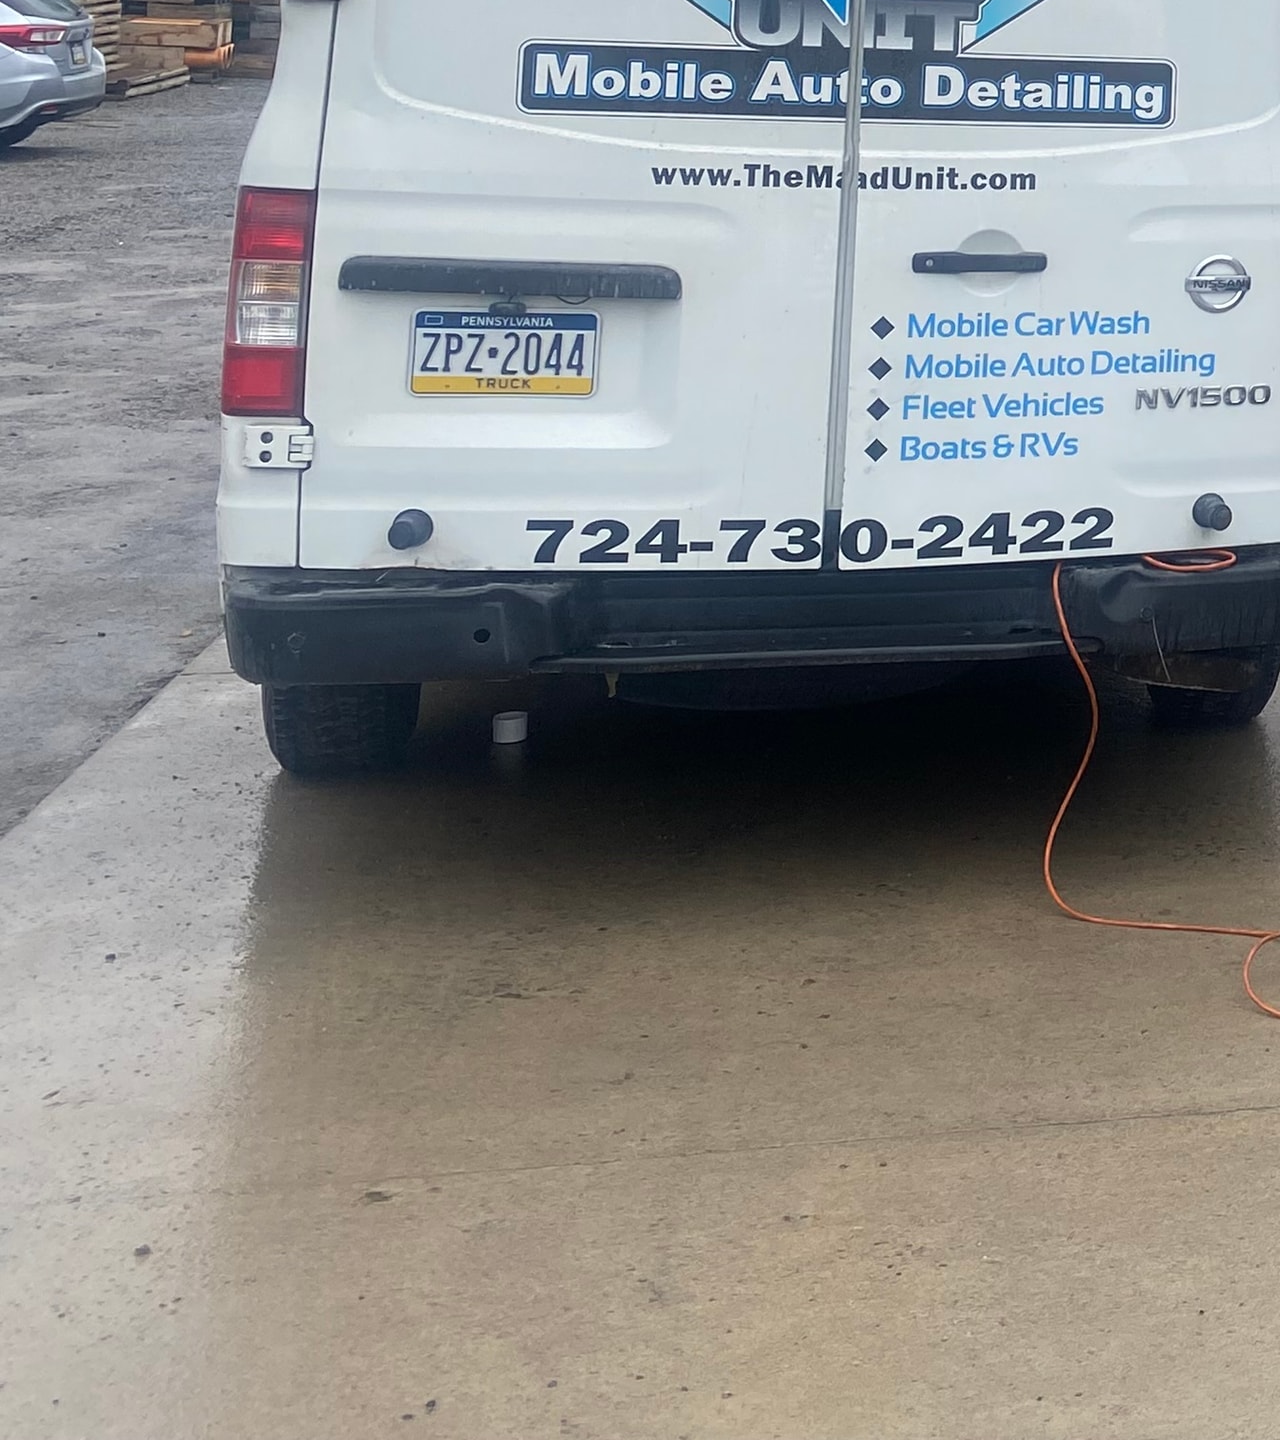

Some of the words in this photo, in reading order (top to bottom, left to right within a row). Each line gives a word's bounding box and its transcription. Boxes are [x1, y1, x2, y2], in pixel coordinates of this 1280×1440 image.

[533, 52, 733, 102] Mobile
[751, 60, 903, 107] Auto
[923, 65, 1165, 121] Detailing
[1193, 279, 1245, 289] NISSAN
[461, 316, 554, 328] PENNSYLVANIA
[906, 313, 1008, 339] Mobile
[1014, 311, 1065, 336] Car
[1069, 310, 1150, 335] Wash
[903, 353, 1006, 379] Mobile
[1010, 352, 1085, 377] Auto
[1090, 348, 1216, 378] Detailing
[475, 377, 532, 390] TRUCK
[1135, 384, 1271, 411] NV1500
[902, 393, 976, 420] Fleet
[982, 392, 1104, 417] Vehicles
[900, 435, 986, 461] Boats
[993, 433, 1015, 459] &
[1019, 432, 1079, 458] RVs
[525, 507, 1114, 564] 724-730-2422
